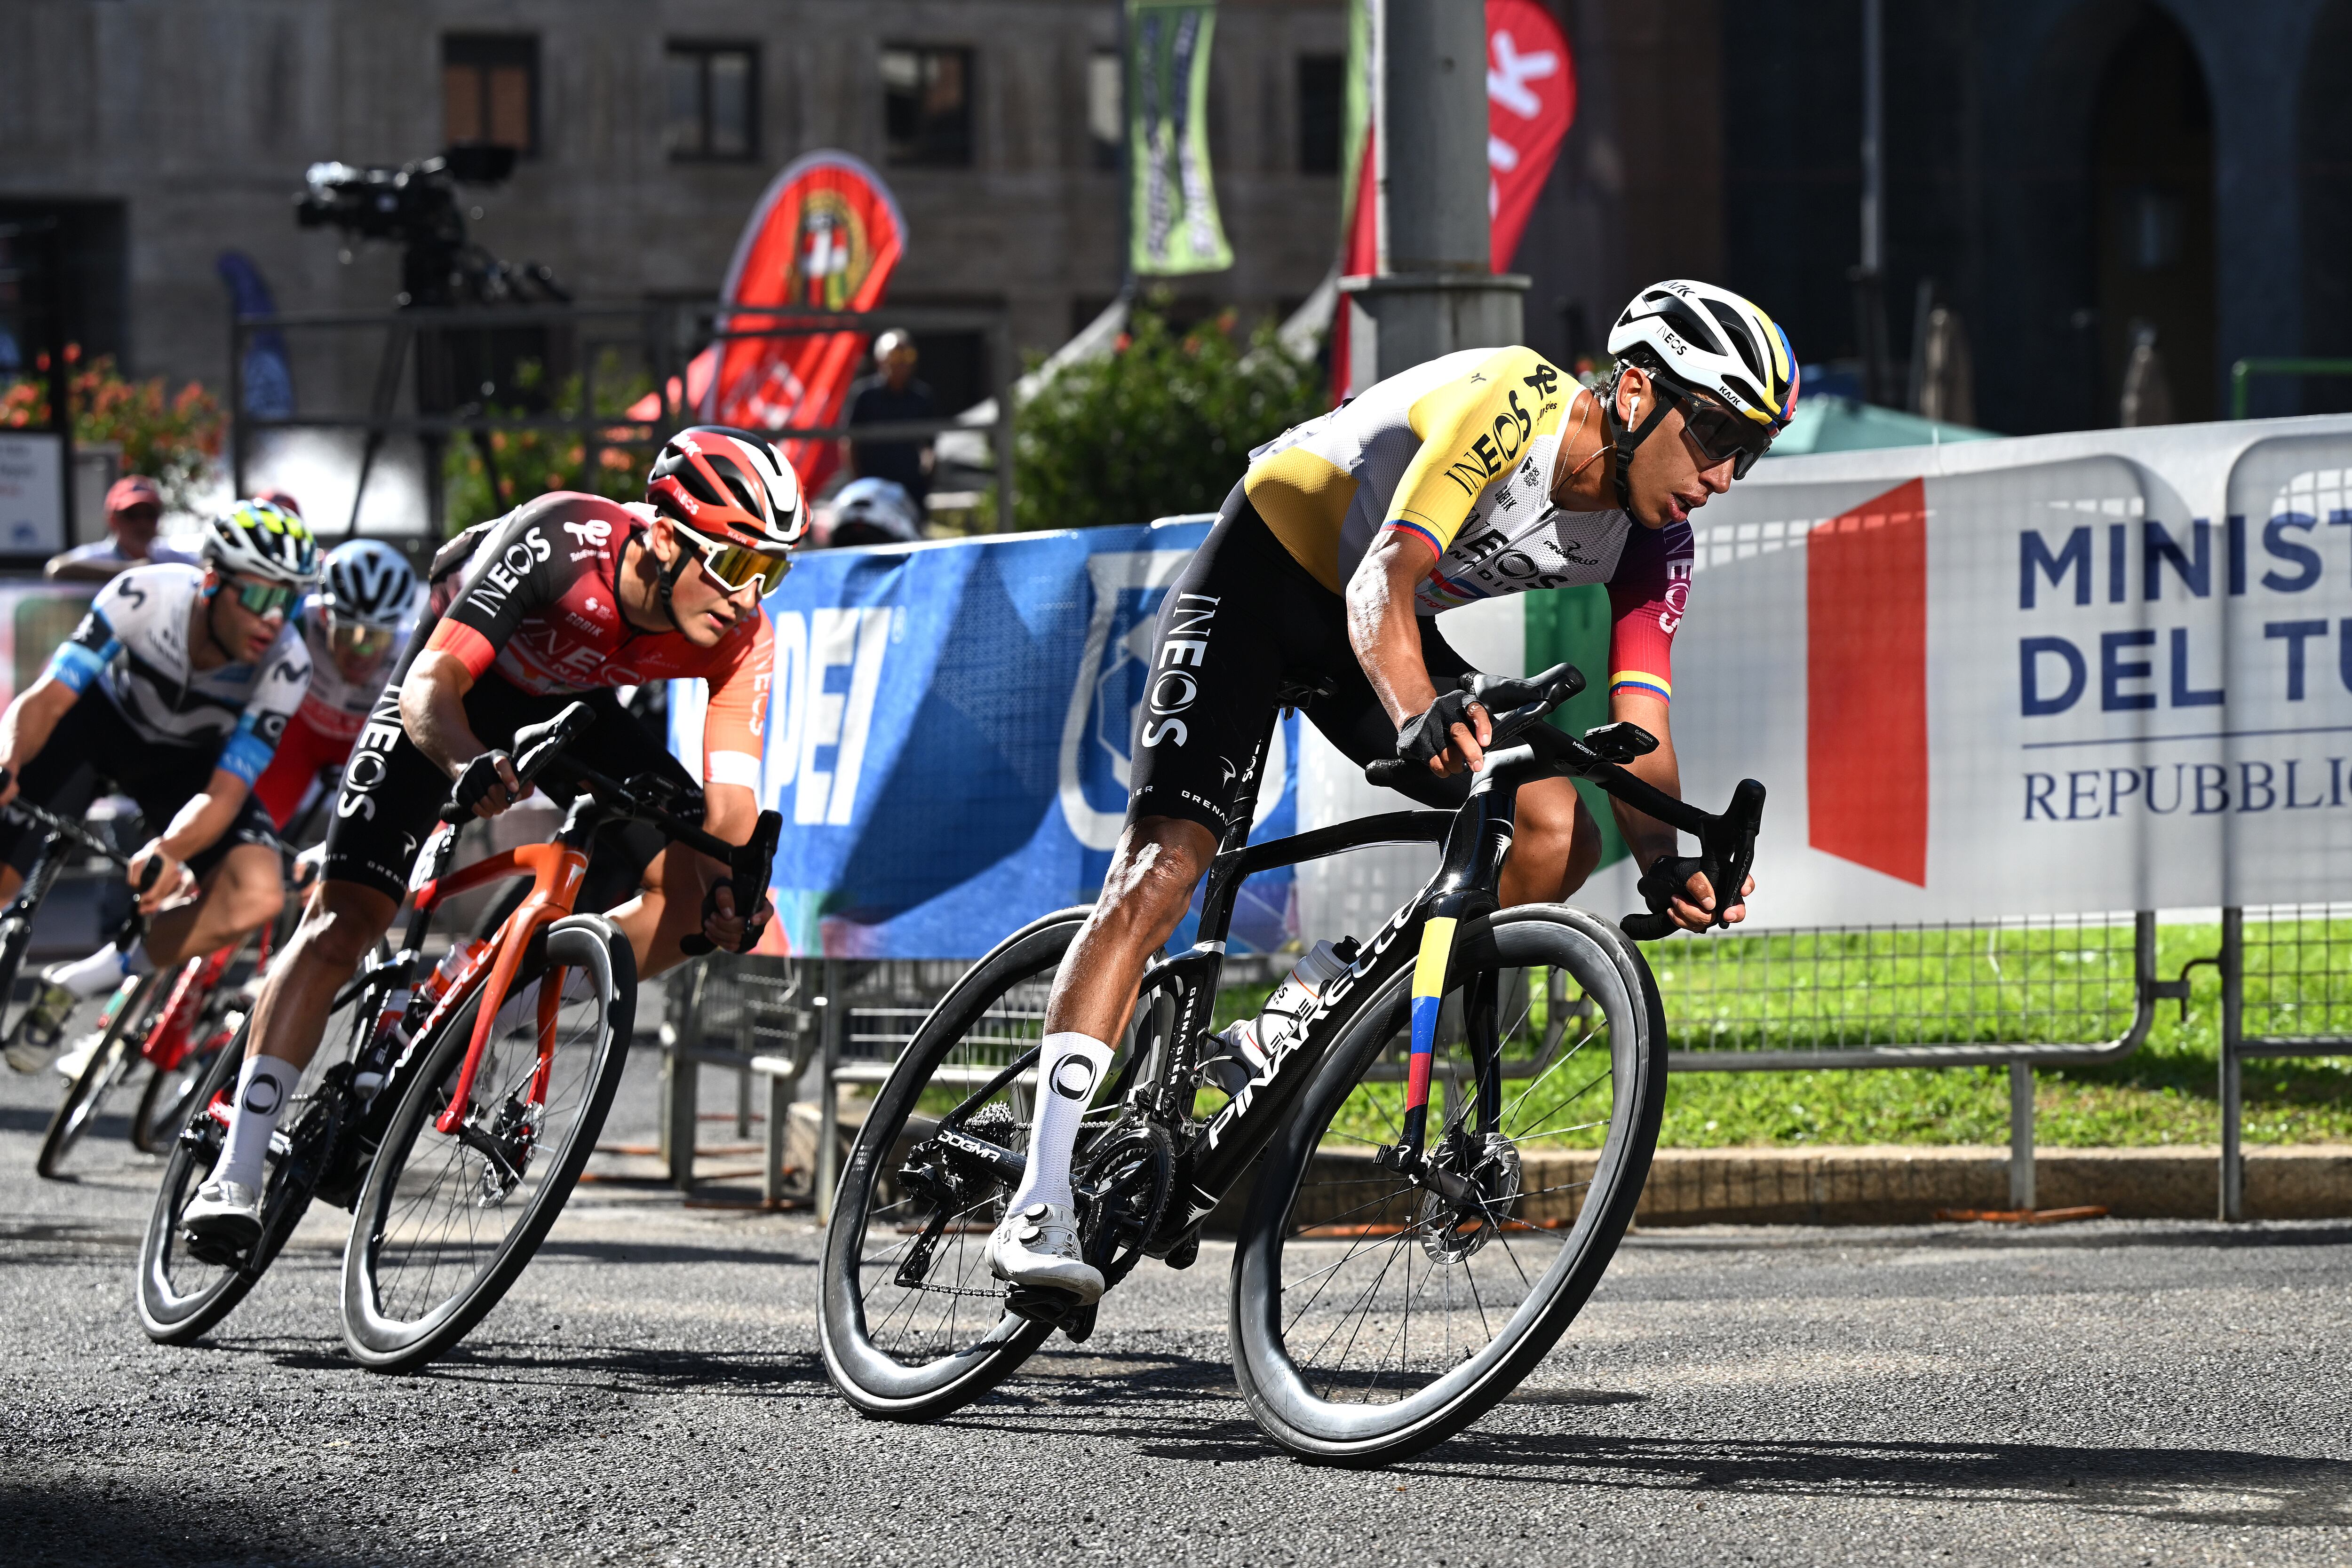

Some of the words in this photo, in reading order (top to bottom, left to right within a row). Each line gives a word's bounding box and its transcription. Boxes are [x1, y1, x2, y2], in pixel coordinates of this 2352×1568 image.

[1656, 325, 1687, 356] INEOS
[1718, 386, 1741, 406] KASK
[1444, 390, 1531, 498] INEOS
[673, 486, 699, 515] INEOS
[1524, 475, 1533, 487] TEAM
[1528, 471, 1539, 486] WORLD
[467, 526, 551, 619] INEOS
[1455, 507, 1569, 589] NEOS
[1543, 540, 1598, 565] PINARELLO
[1141, 591, 1221, 748] INEOS
[2020, 627, 2225, 716] DEL
[2264, 617, 2352, 701] T
[1635, 729, 1653, 743] GARMIN
[2023, 756, 2352, 821] REPUBBLI
[1170, 987, 1197, 1085] GRENADIER
[1208, 891, 1423, 1150] PINARELLO
[937, 1130, 1001, 1163] DOGMA
